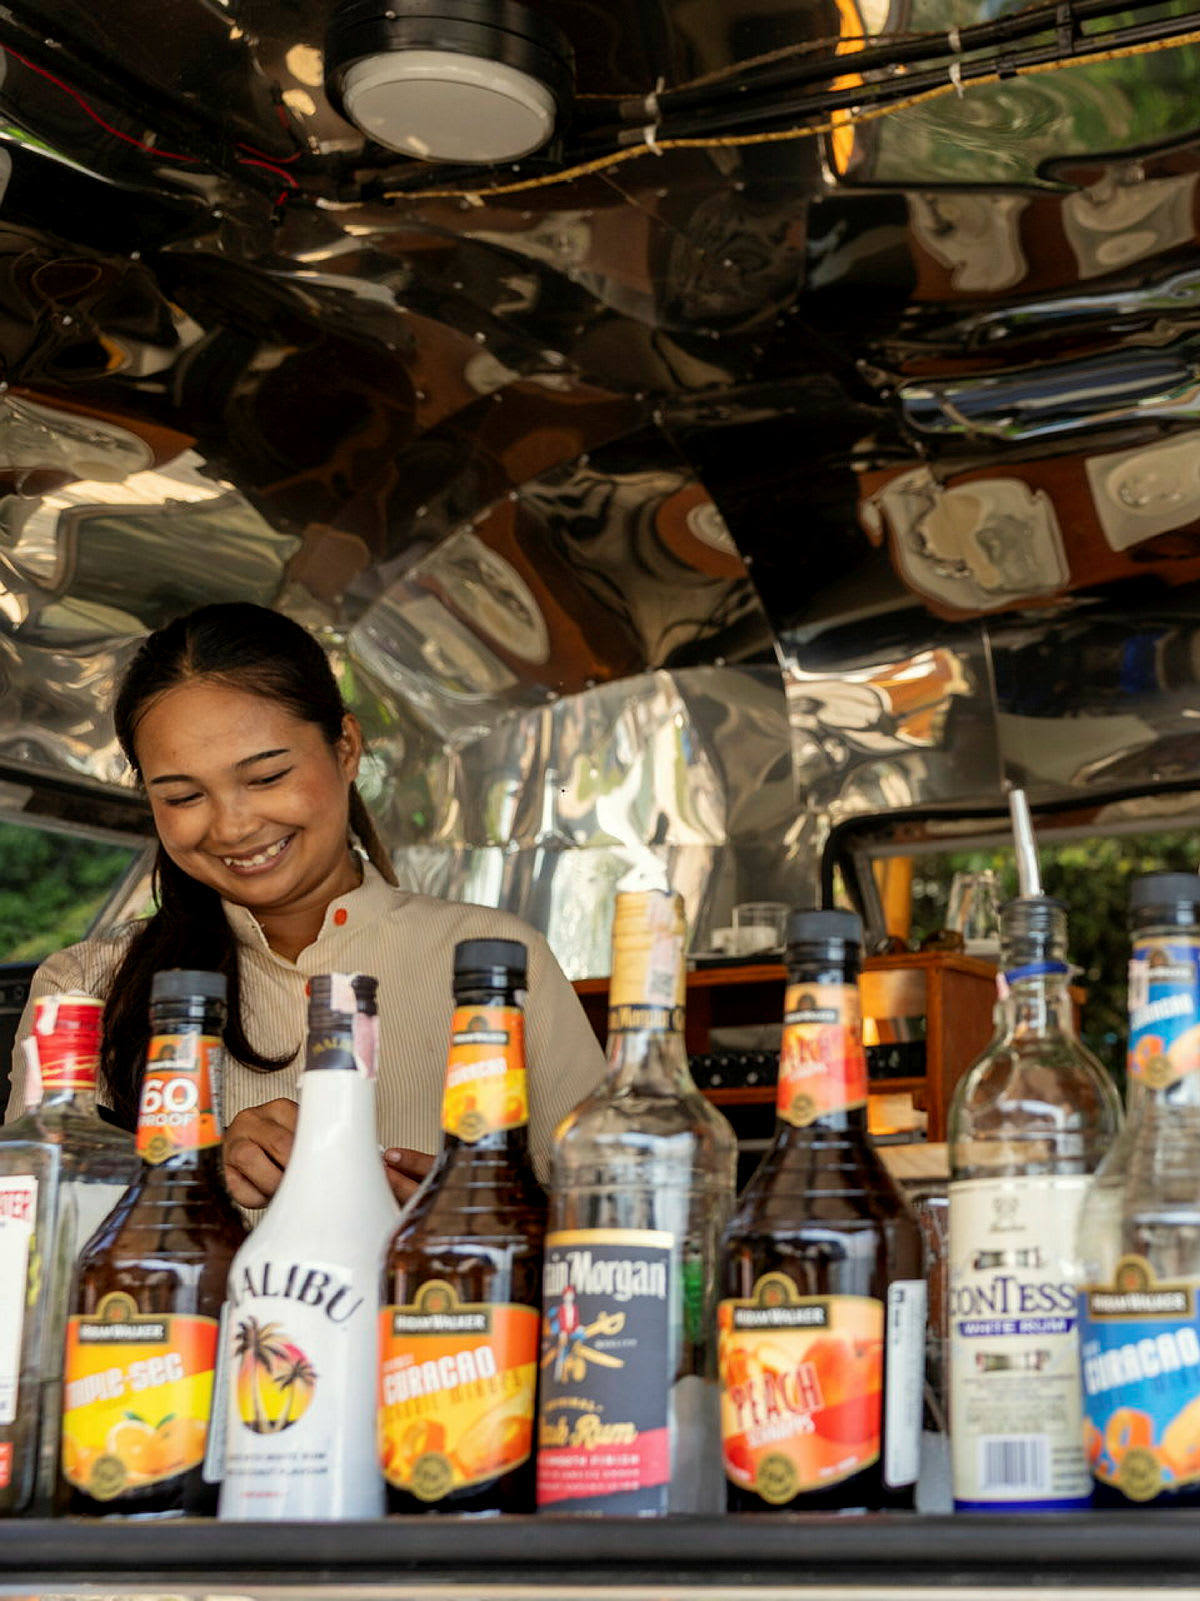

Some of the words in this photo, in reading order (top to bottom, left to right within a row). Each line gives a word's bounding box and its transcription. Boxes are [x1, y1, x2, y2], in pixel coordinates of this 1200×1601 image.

[141, 1077, 199, 1113] 60
[240, 1262, 365, 1323] ALIBU
[565, 1250, 667, 1302] Morgan
[730, 1361, 826, 1430] PEACH
